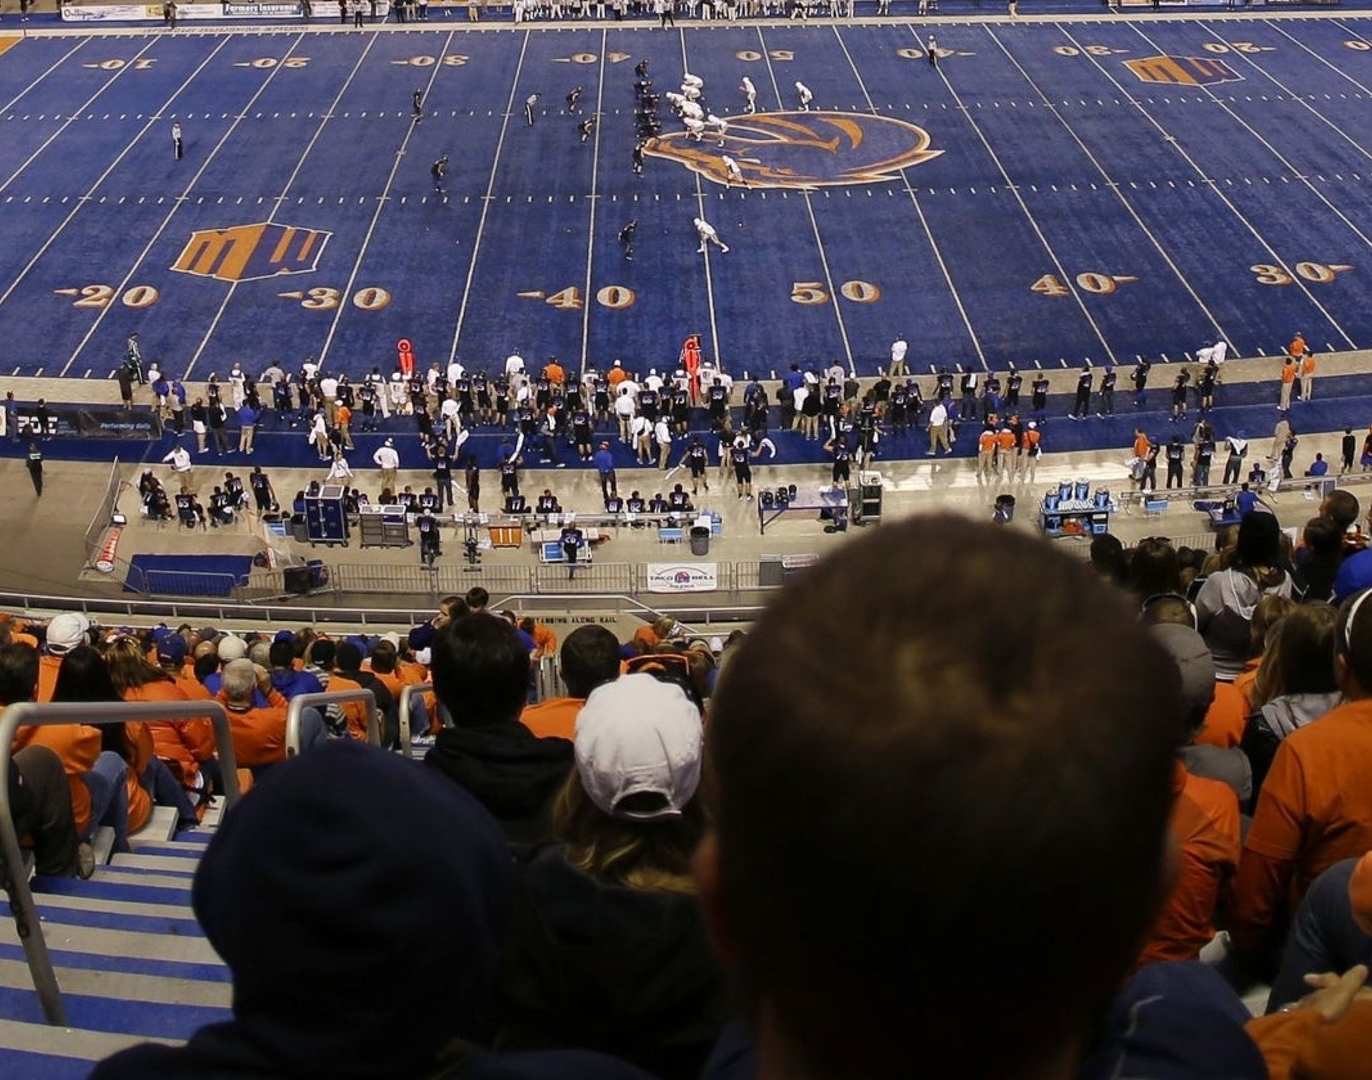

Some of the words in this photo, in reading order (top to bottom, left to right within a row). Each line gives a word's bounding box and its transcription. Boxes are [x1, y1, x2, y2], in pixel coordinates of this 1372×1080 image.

[1030, 272, 1116, 296] 40
[1249, 261, 1334, 286] 30
[73, 284, 160, 310] 20
[301, 287, 392, 312] 30
[544, 285, 636, 308] 40
[790, 280, 881, 306] 50
[650, 574, 673, 582] TACO
